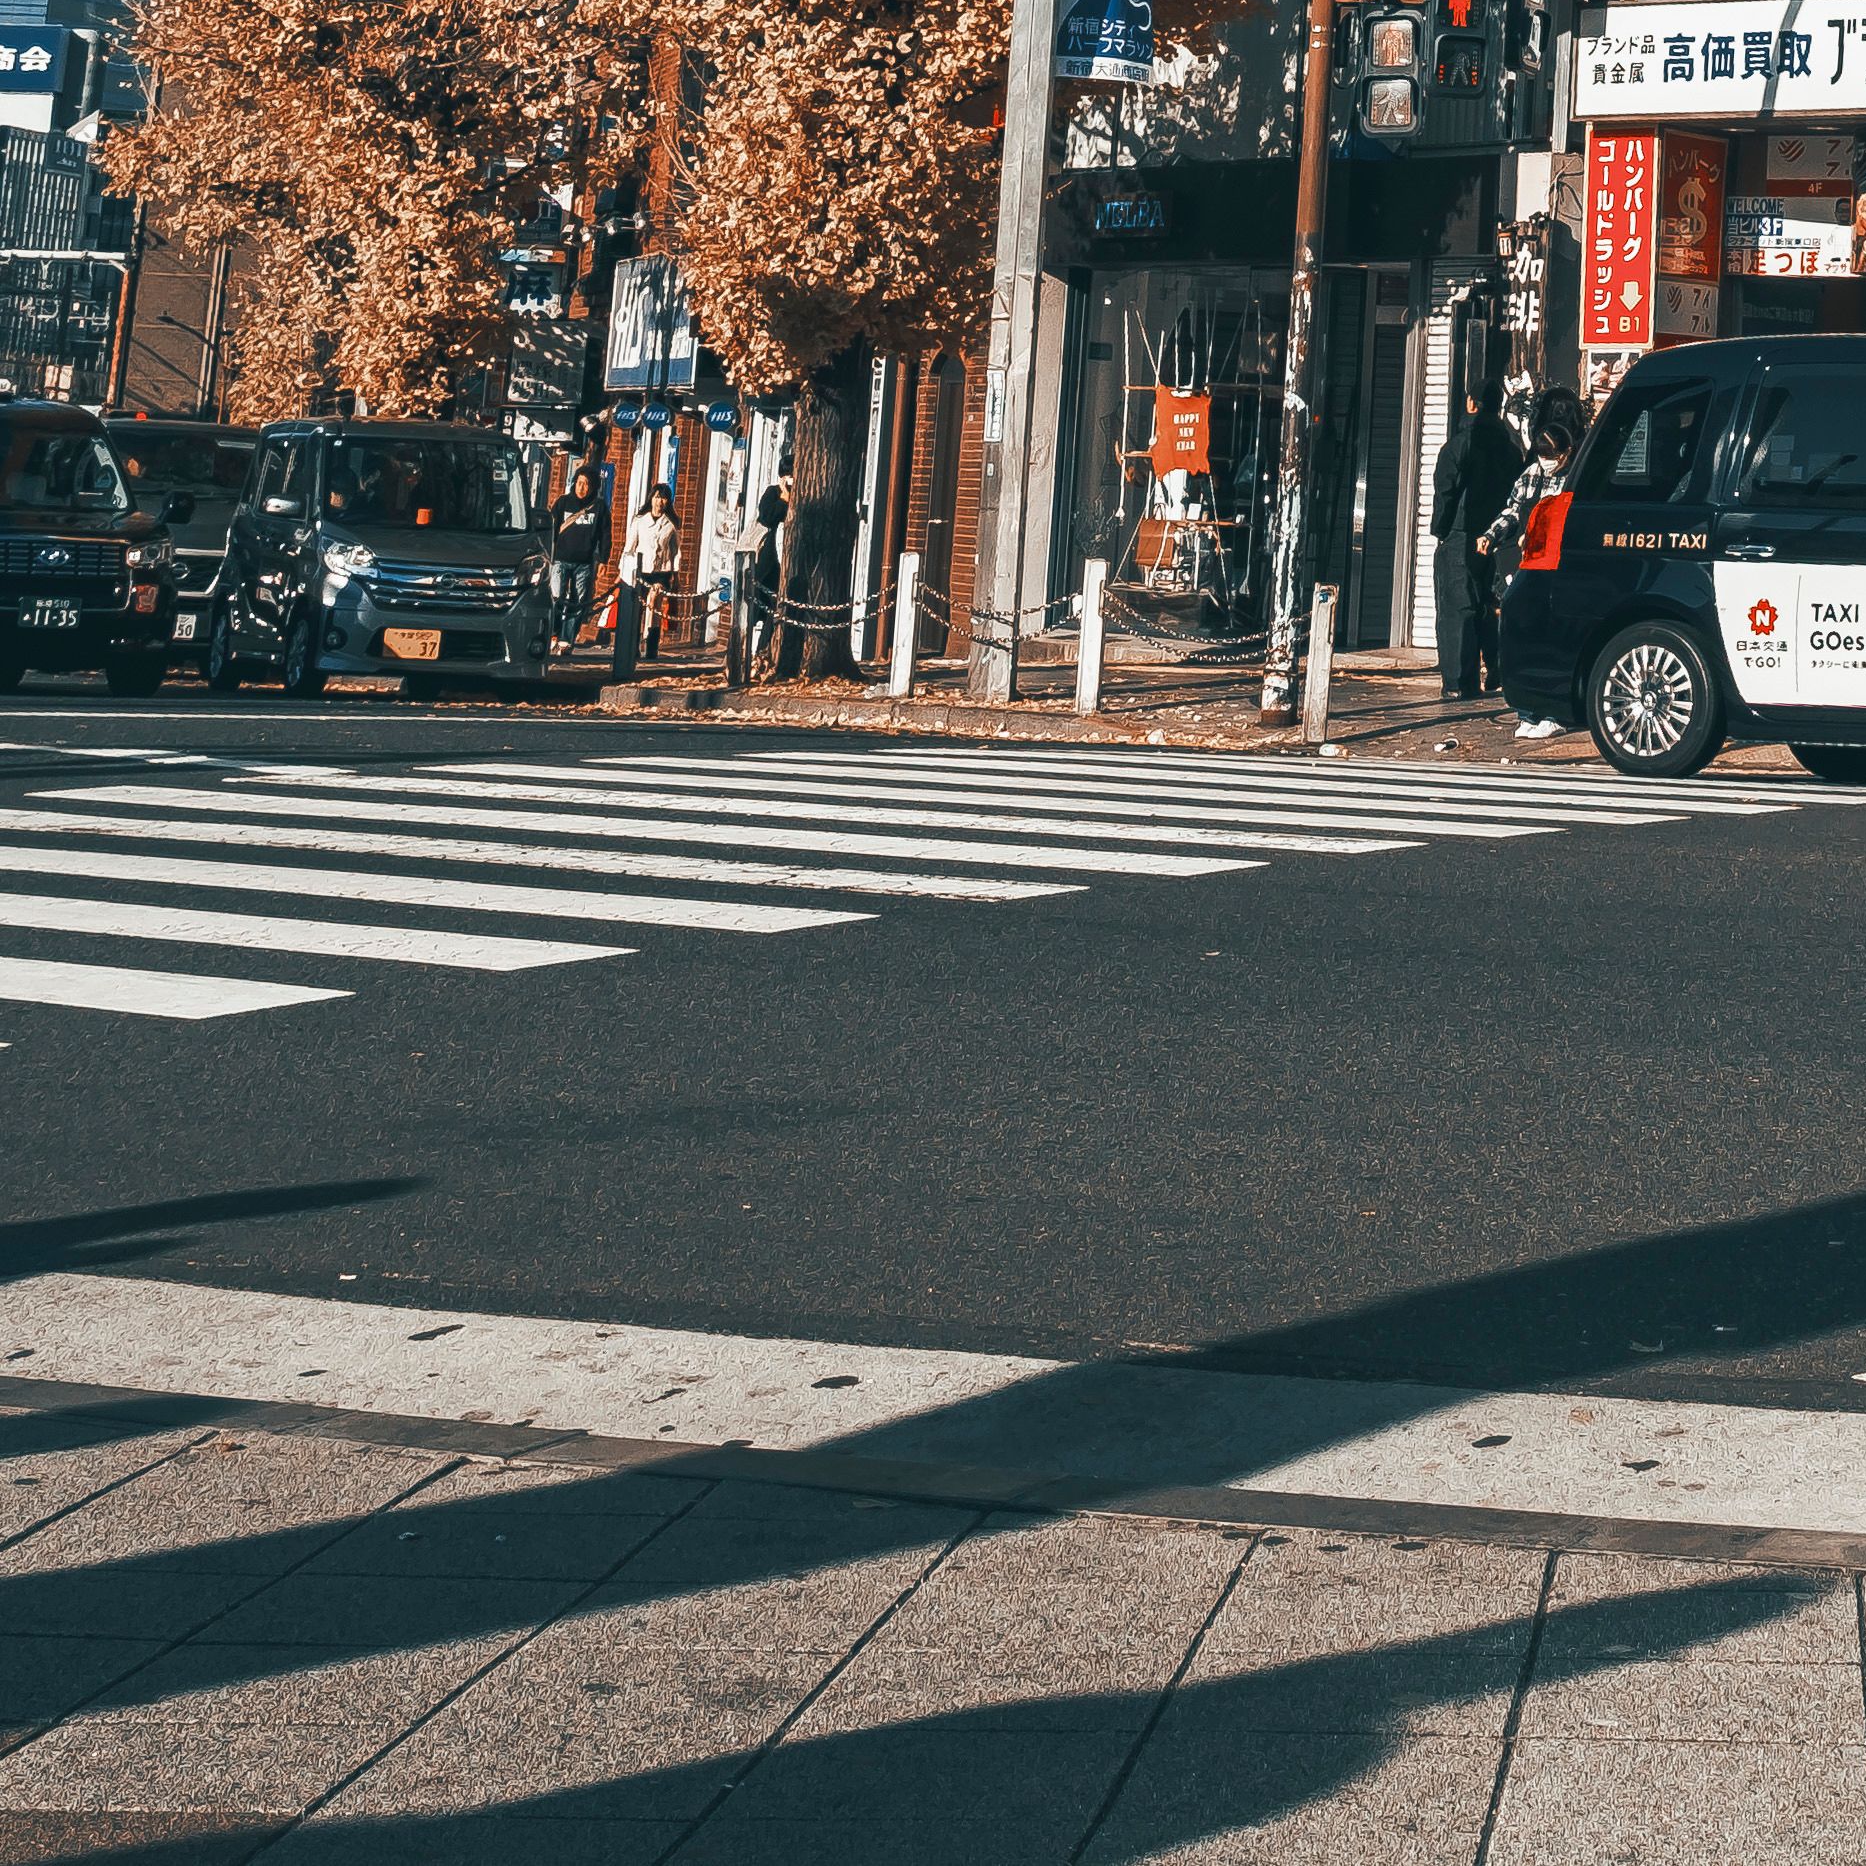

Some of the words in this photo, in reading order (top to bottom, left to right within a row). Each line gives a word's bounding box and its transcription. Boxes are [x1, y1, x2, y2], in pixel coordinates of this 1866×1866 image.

[1068, 16, 1136, 39] 新宿シティ
[1067, 35, 1154, 60] ハーフマラソン
[1586, 35, 1657, 57] ブランド品
[1662, 31, 1813, 83] 高価買取
[1592, 62, 1646, 86] 貴金属
[1622, 138, 1645, 262] ハンバーグ
[1727, 197, 1785, 215] WELCOME
[1592, 139, 1616, 335] ゴールドラッシュ
[1618, 316, 1641, 334] B1
[1668, 533, 1707, 549] TAXI
[33, 609, 79, 627] 11-35
[1810, 603, 1860, 624] TAXI
[1736, 640, 1788, 653] 日本交通
[1810, 631, 1865, 652] GOes
[1743, 656, 1781, 669] でGO!
